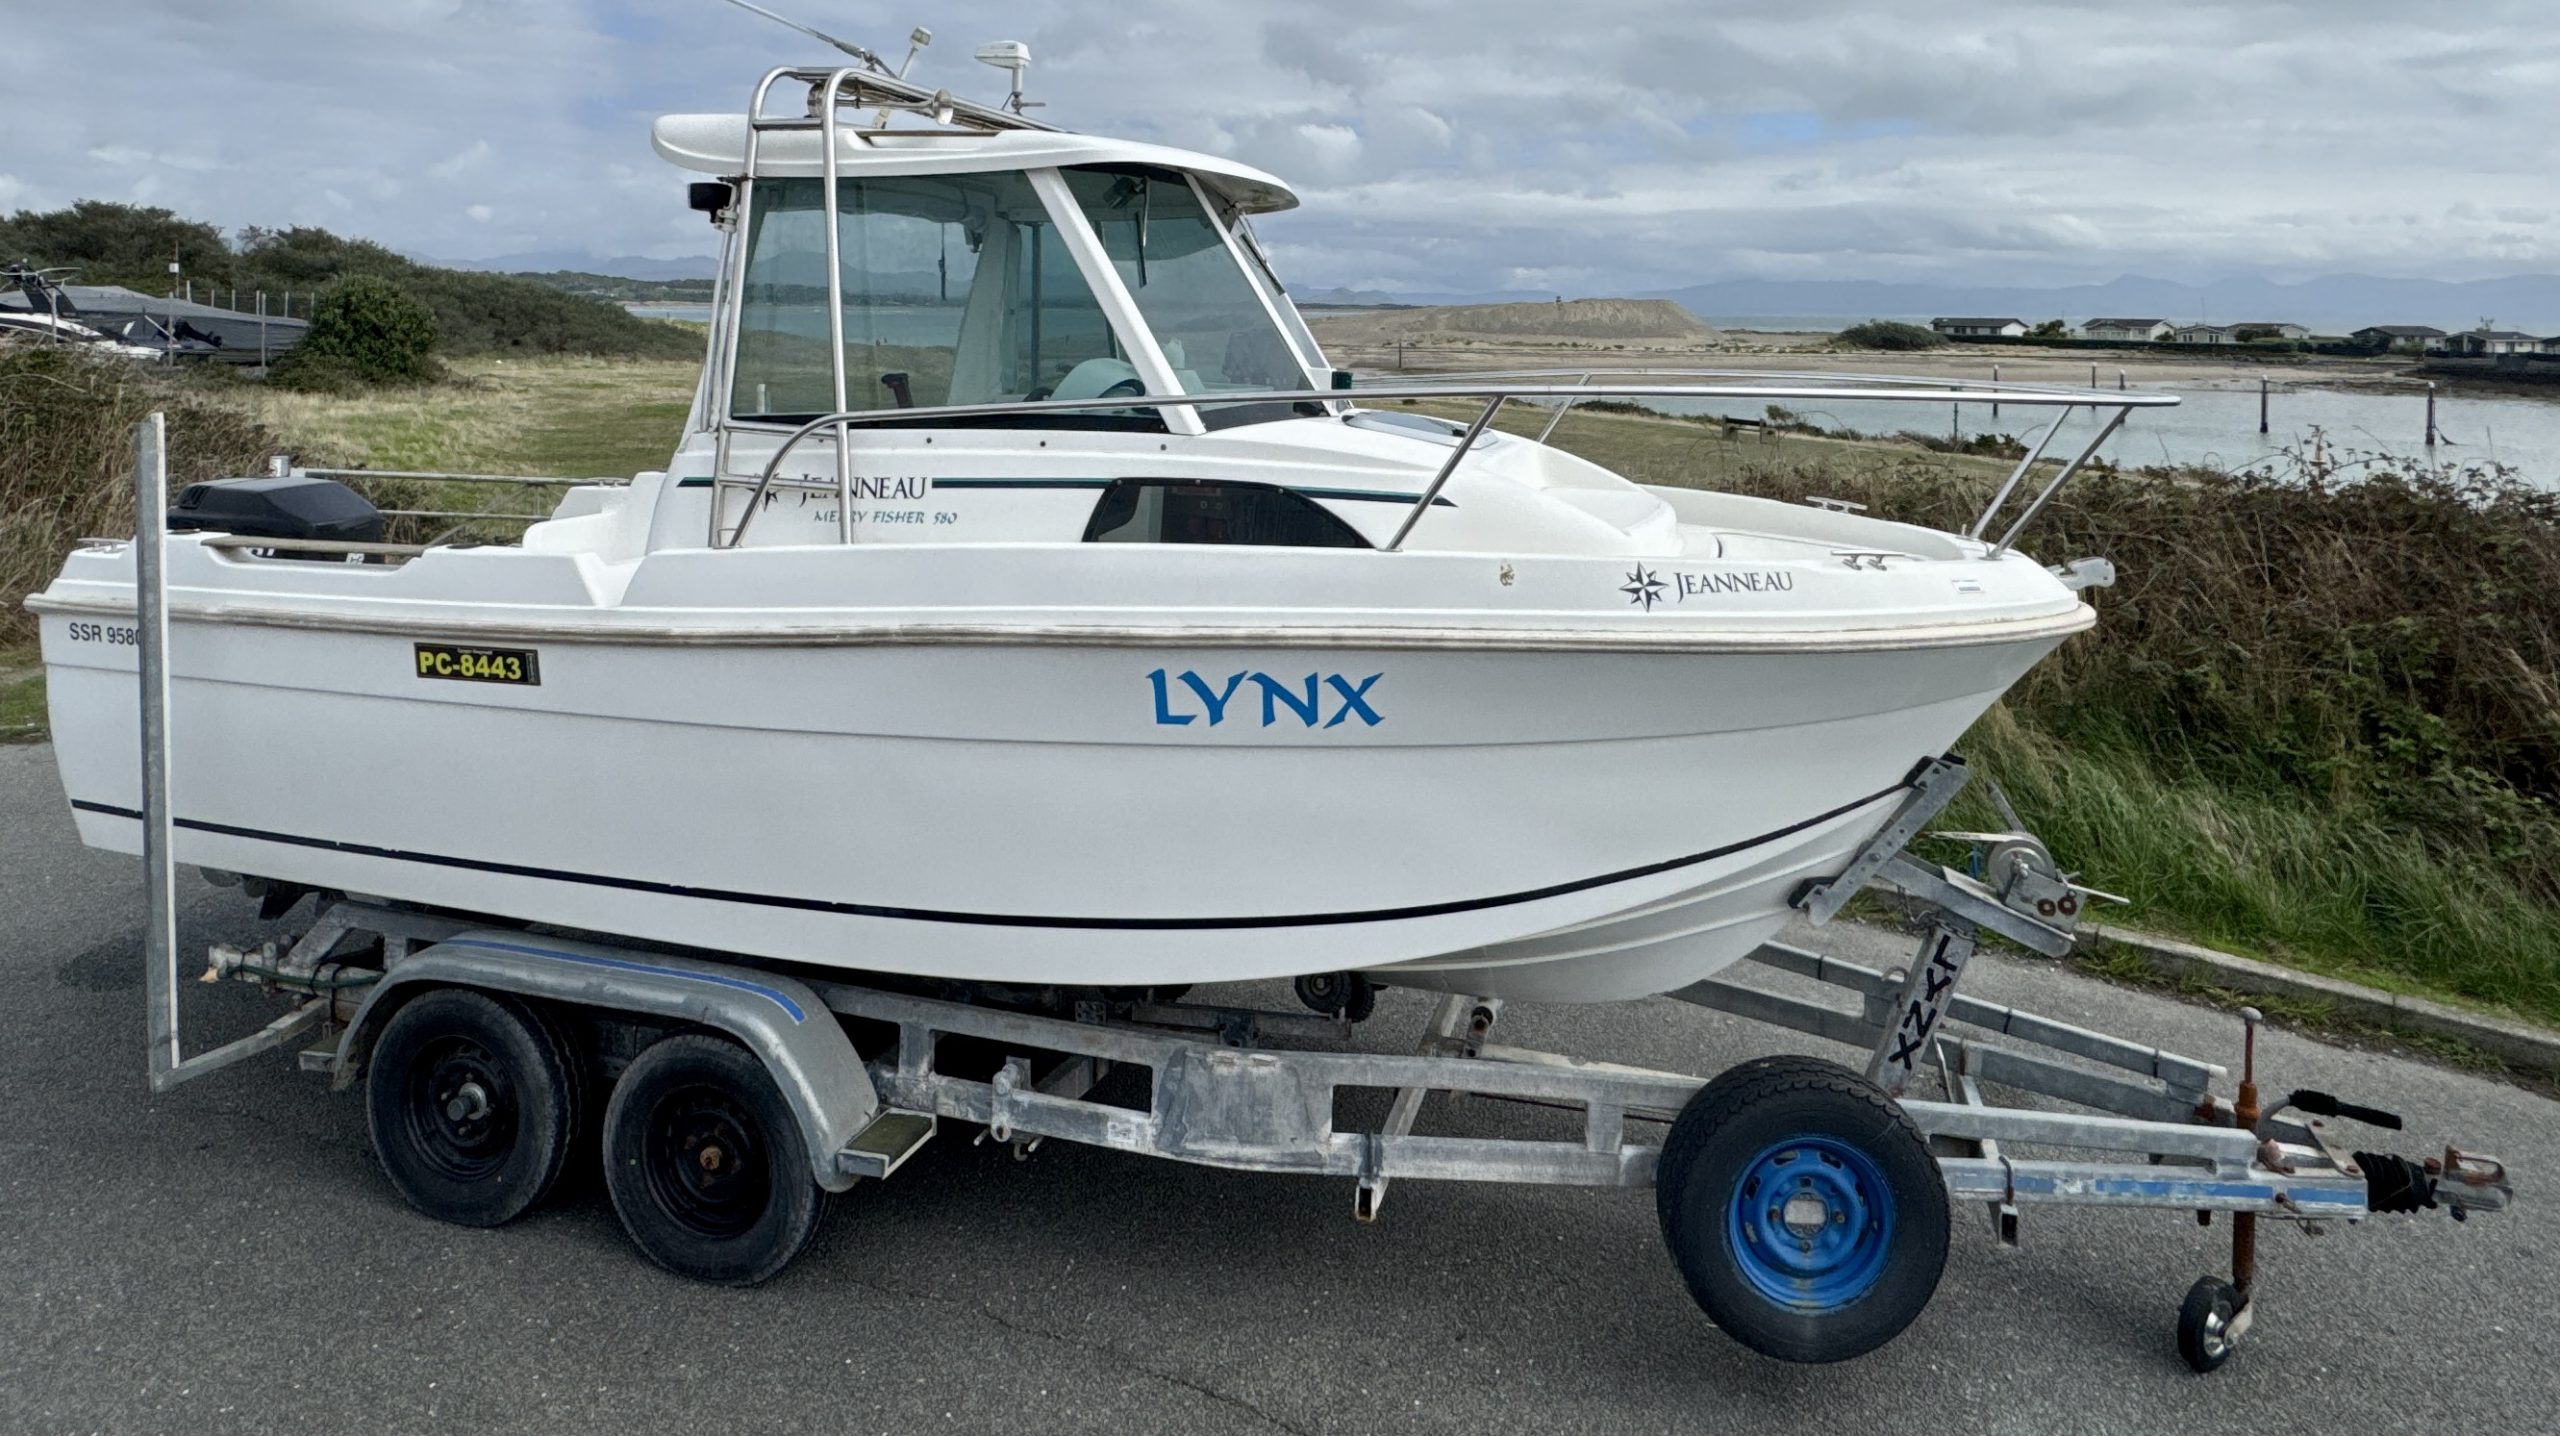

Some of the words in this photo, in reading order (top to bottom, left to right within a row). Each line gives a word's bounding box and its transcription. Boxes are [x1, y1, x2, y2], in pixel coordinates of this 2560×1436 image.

[799, 473, 927, 507] JNNEAU
[814, 510, 867, 524] MERY
[872, 510, 924, 524] FISHER
[932, 511, 957, 525] 580
[1673, 571, 1793, 603] JEANNEAU
[69, 622, 102, 642] SSR
[419, 651, 522, 680] PC-8443
[1146, 668, 1385, 729] LYNX
[1888, 934, 1958, 1071] LYNX
